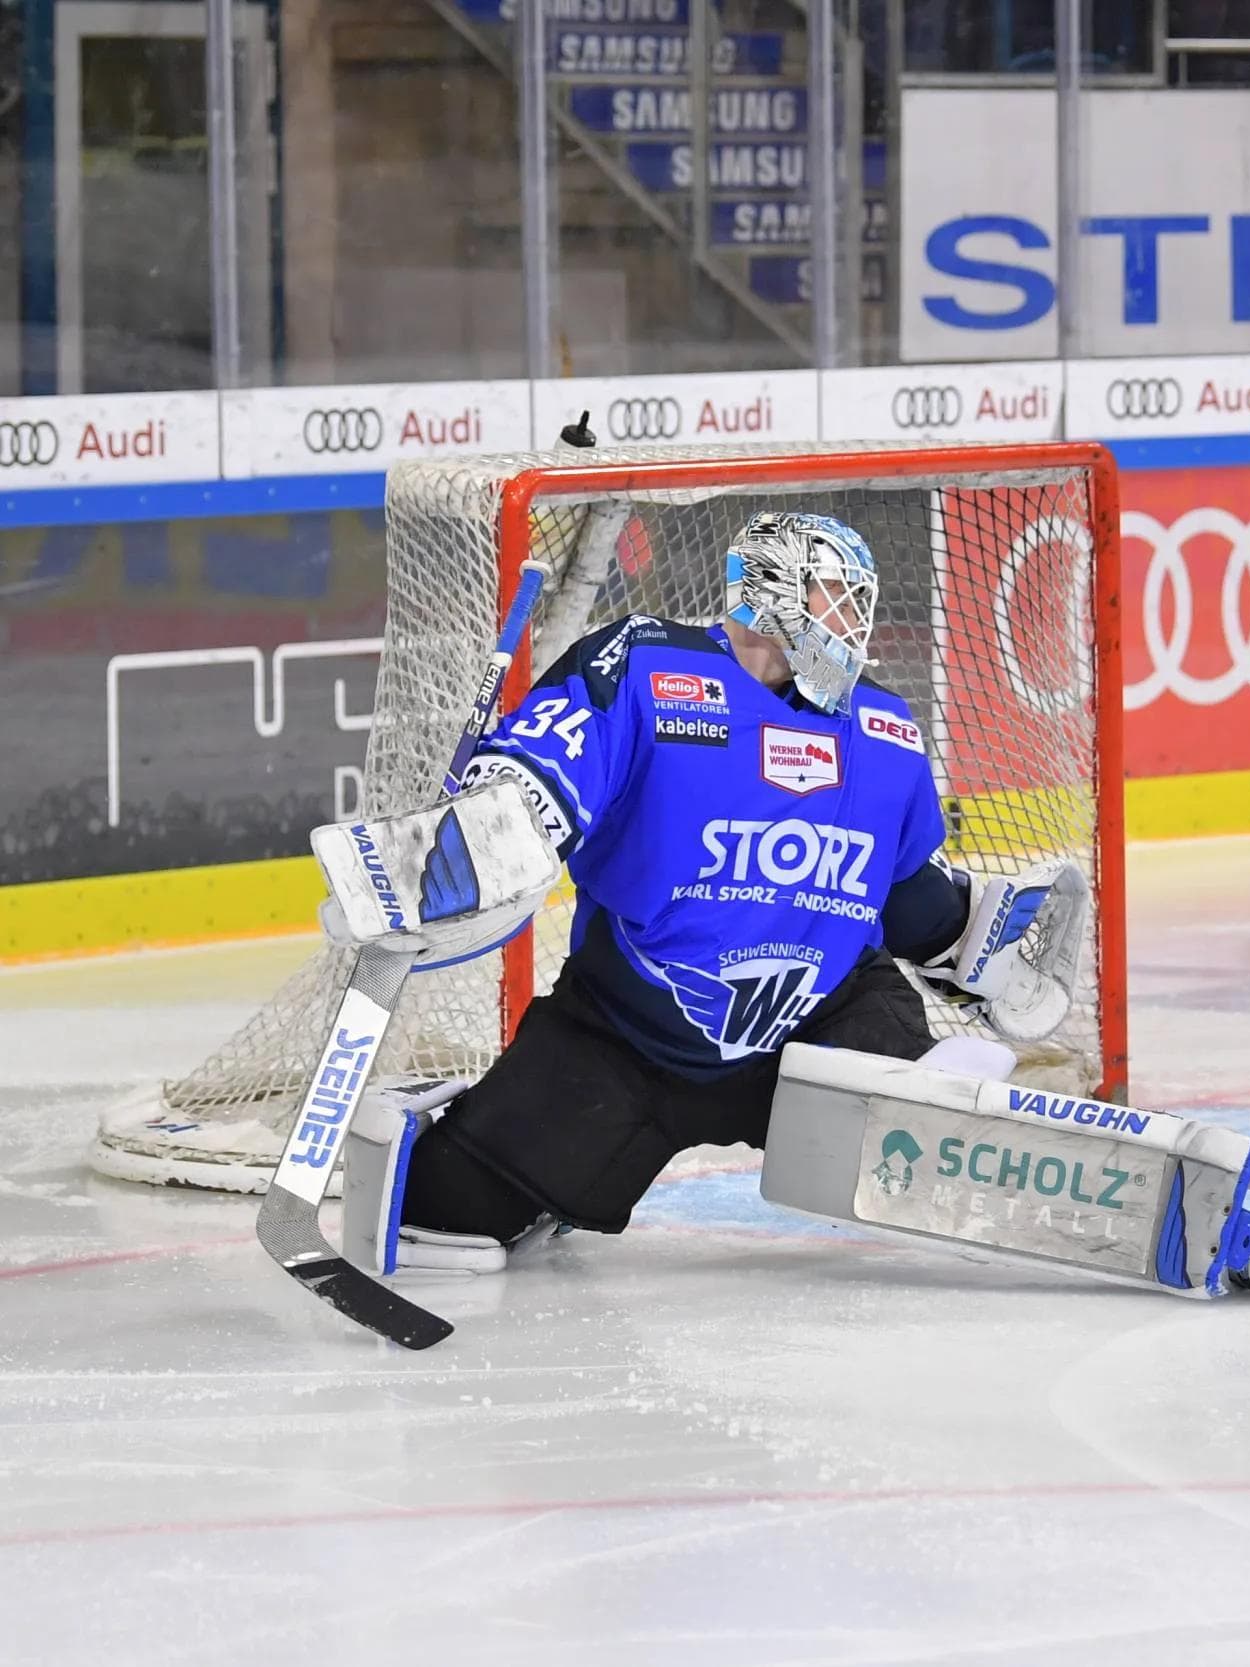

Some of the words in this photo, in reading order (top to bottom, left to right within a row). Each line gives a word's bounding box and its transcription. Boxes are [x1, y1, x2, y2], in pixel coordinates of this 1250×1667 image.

[695, 398, 773, 435] Audi
[975, 386, 1049, 422] Audi
[76, 421, 167, 461] Audi
[400, 408, 483, 447] Audi
[657, 681, 700, 695] Helios
[653, 701, 730, 716] VENTILATOREN
[655, 716, 729, 739] kabeltec
[510, 698, 593, 761] 34
[868, 716, 919, 745] DEL
[769, 744, 803, 756] WERNER
[769, 755, 812, 767] WOHNBAU
[698, 818, 875, 897] STORZ
[350, 824, 407, 930] VAUGHN
[671, 884, 714, 902] KARL
[717, 886, 779, 905] STORZ
[966, 882, 1016, 984] VAUGHN
[1009, 1089, 1152, 1136] VAUGHN
[936, 1136, 1130, 1211] SCHOLZ
[931, 1183, 1119, 1241] METALL
